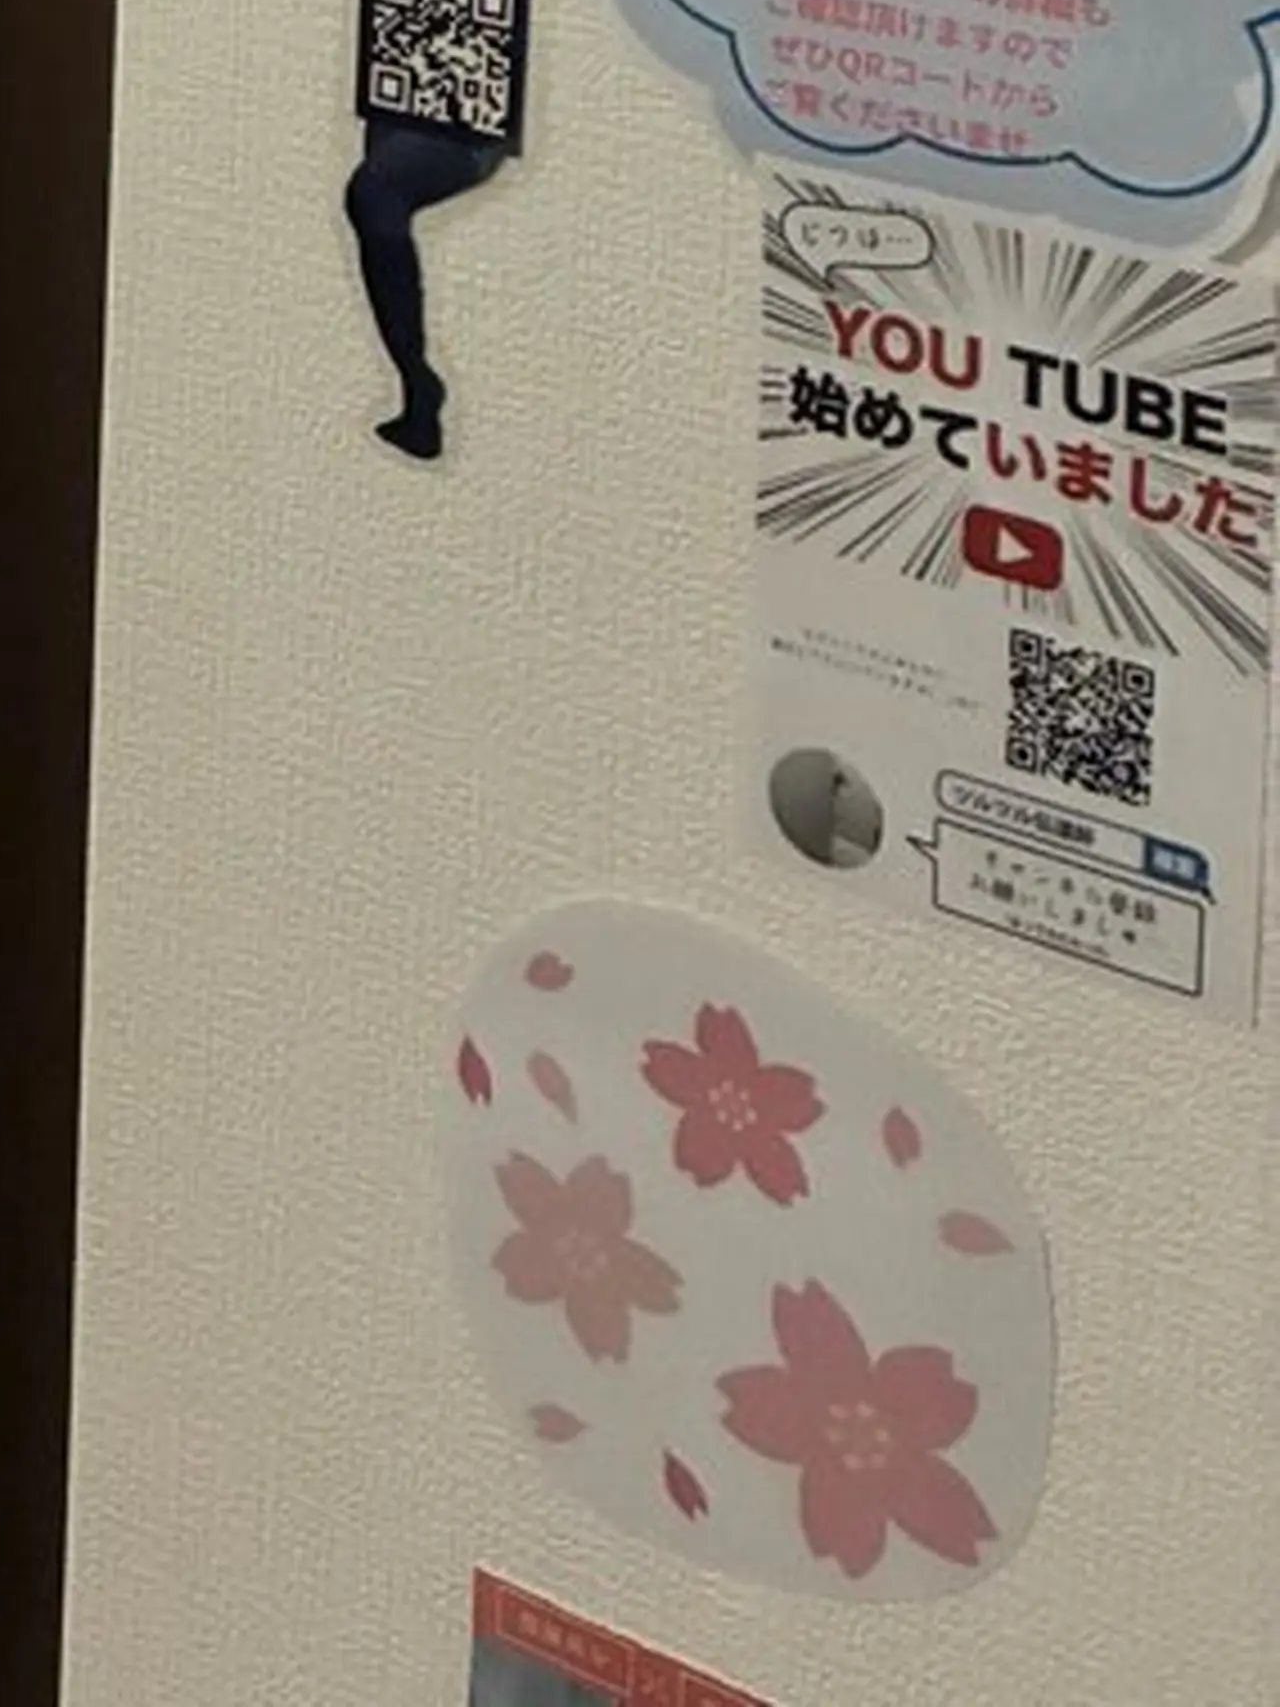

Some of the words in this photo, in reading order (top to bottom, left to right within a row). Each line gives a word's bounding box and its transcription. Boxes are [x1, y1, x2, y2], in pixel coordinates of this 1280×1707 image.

[788, 366, 1260, 549] 始めていました
[825, 299, 983, 389] YOU
[1006, 343, 1229, 456] TUBE
